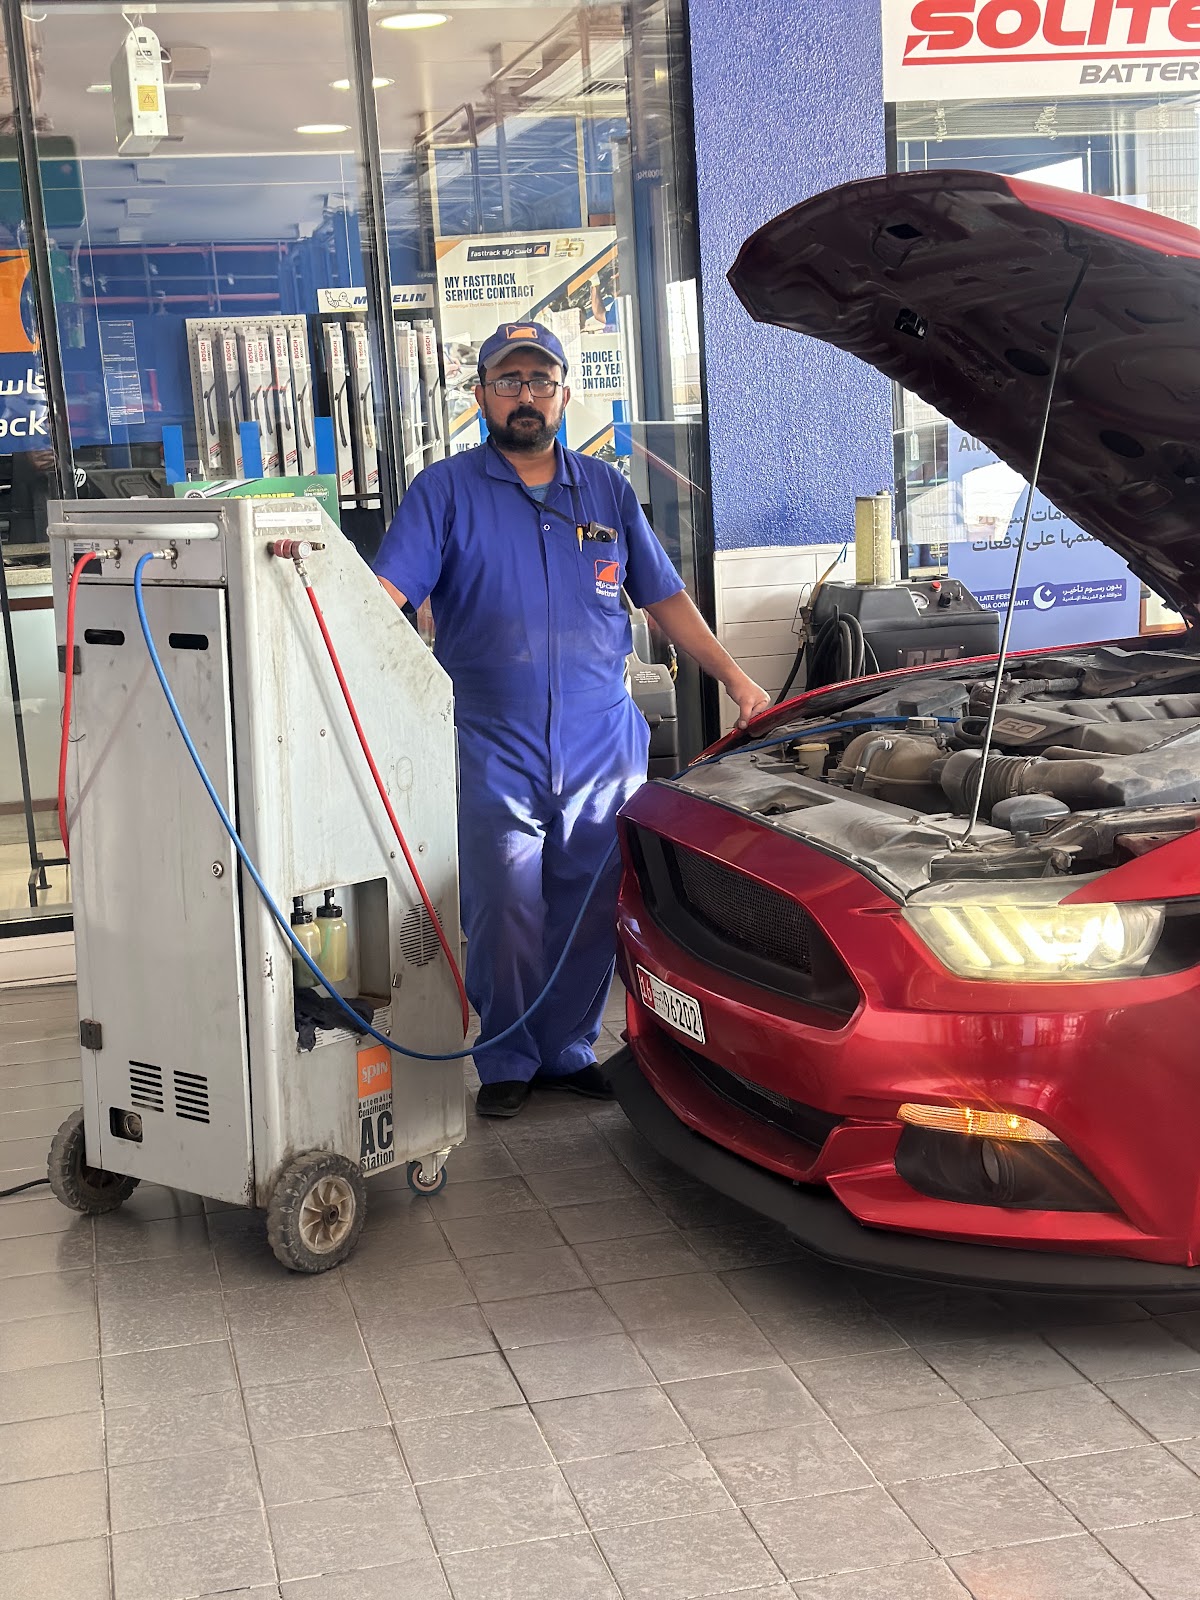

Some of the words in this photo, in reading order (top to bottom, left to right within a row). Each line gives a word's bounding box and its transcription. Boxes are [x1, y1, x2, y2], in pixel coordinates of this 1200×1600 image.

[1079, 61, 1200, 84] BATTER
[470, 249, 500, 258] fasttrack
[444, 276, 460, 289] MY
[463, 273, 516, 288] FASTTRACK
[353, 292, 427, 305] MELIN
[445, 286, 484, 302] SERVICE
[486, 284, 535, 299] CONTRACT
[199, 341, 207, 362] BOSCH
[581, 351, 613, 364] CHOICE
[595, 364, 602, 376] 2
[604, 363, 624, 376] YEA
[1026, 530, 1056, 551] على
[1084, 586, 1105, 595] رسوم
[1106, 584, 1123, 592] بدون
[979, 593, 995, 602] LATE
[663, 990, 700, 1037] 96202
[358, 1092, 393, 1111] Automatic
[360, 1110, 394, 1159] AC
